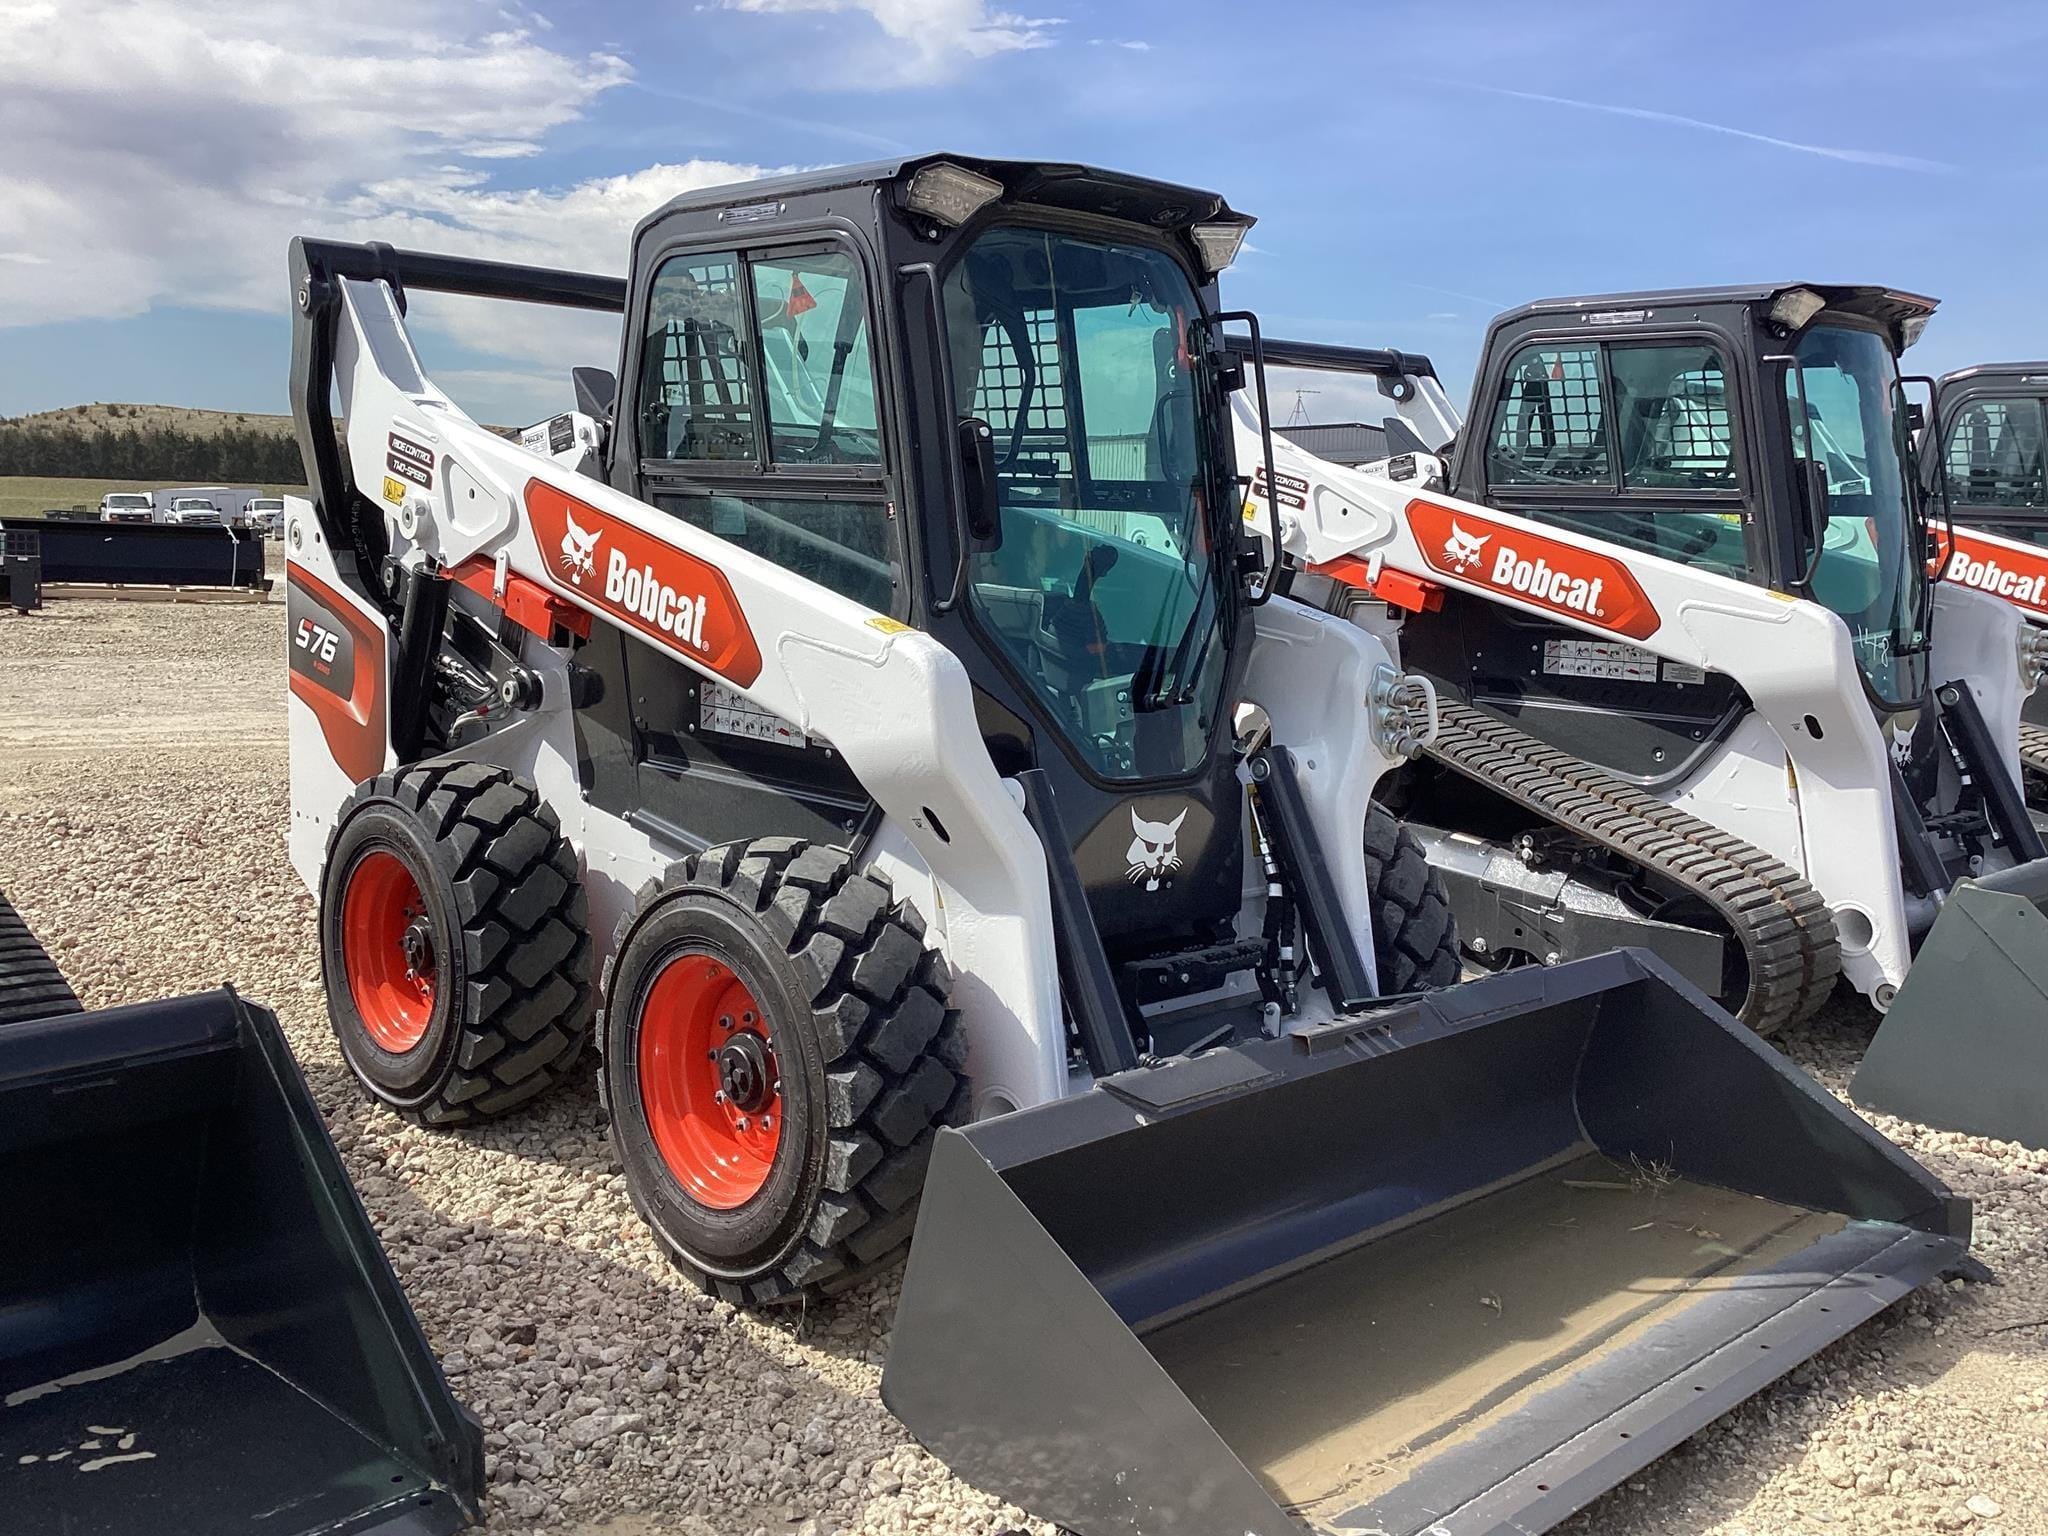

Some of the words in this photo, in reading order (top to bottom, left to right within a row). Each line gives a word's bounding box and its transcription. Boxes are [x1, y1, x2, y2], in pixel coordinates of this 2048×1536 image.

[392, 438, 406, 452] RIDE
[405, 444, 431, 464] CONTROL
[393, 460, 427, 482] TWO-SPEED
[1275, 475, 1306, 491] CONTROL
[605, 547, 707, 650] Bobcat
[1491, 544, 1603, 615] Bobcat
[1946, 551, 2046, 604] Bobcat
[295, 618, 339, 663] S76
